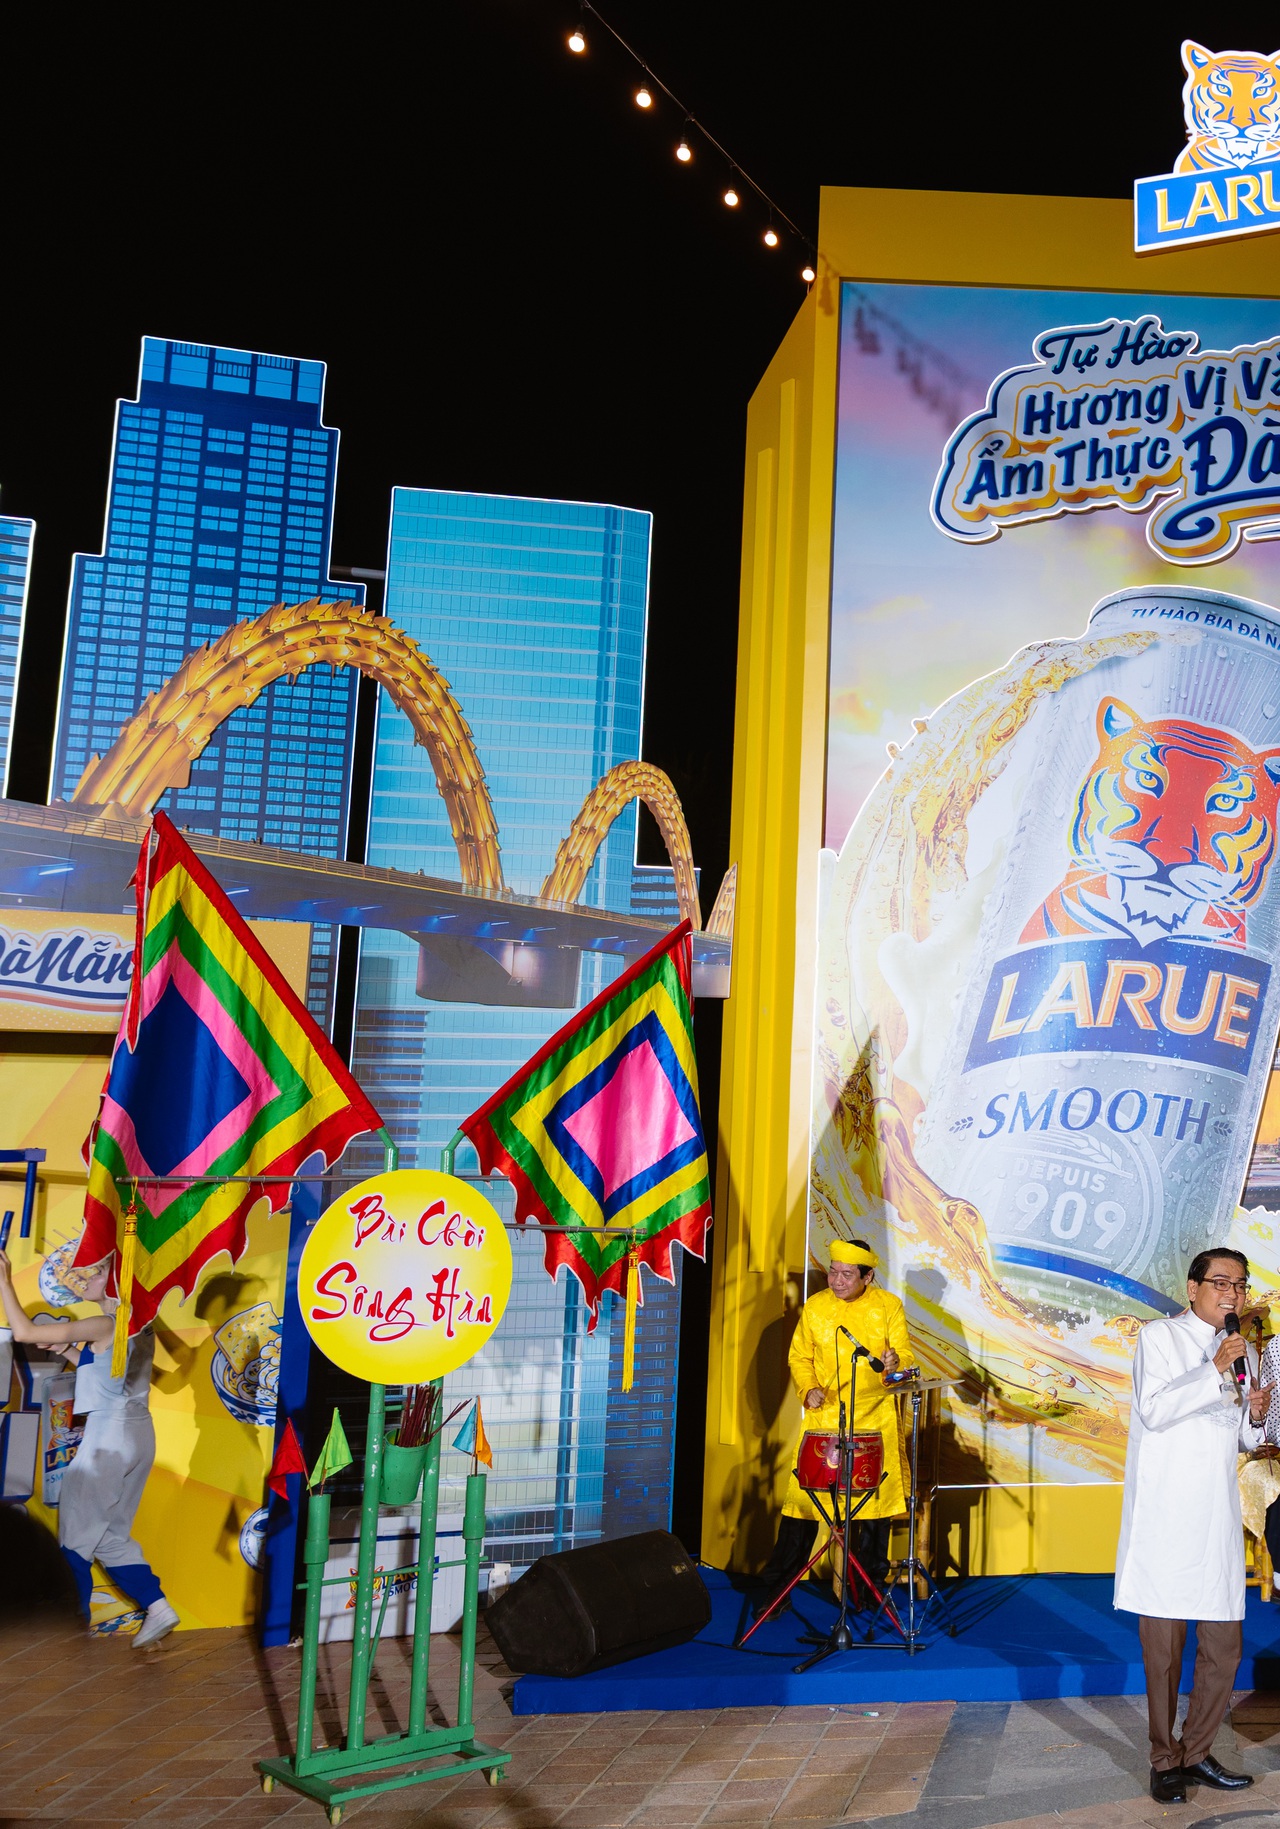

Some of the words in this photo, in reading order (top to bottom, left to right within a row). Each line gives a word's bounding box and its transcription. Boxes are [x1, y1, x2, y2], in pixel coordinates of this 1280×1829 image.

[1039, 322, 1114, 375] Tự
[1108, 319, 1190, 368] Hào
[1023, 381, 1170, 437] Hương
[1184, 365, 1227, 413] Vị
[963, 439, 1044, 506] Ẩm
[1053, 435, 1172, 491] Thực
[1158, 606, 1200, 623] HÀO
[1203, 613, 1233, 632] BIA
[1237, 623, 1261, 642] ĐÀ
[0, 934, 32, 977] à
[35, 935, 135, 985] Nẵn
[988, 959, 1260, 1048] LARUE
[977, 1086, 1212, 1145] SMOOTH
[1012, 1157, 1107, 1193] DEPUIS
[349, 1194, 407, 1248] Bài
[417, 1200, 485, 1249] Chòi
[311, 1261, 430, 1342] Sông
[425, 1267, 492, 1338] Hàn
[47, 1447, 77, 1468] LAR
